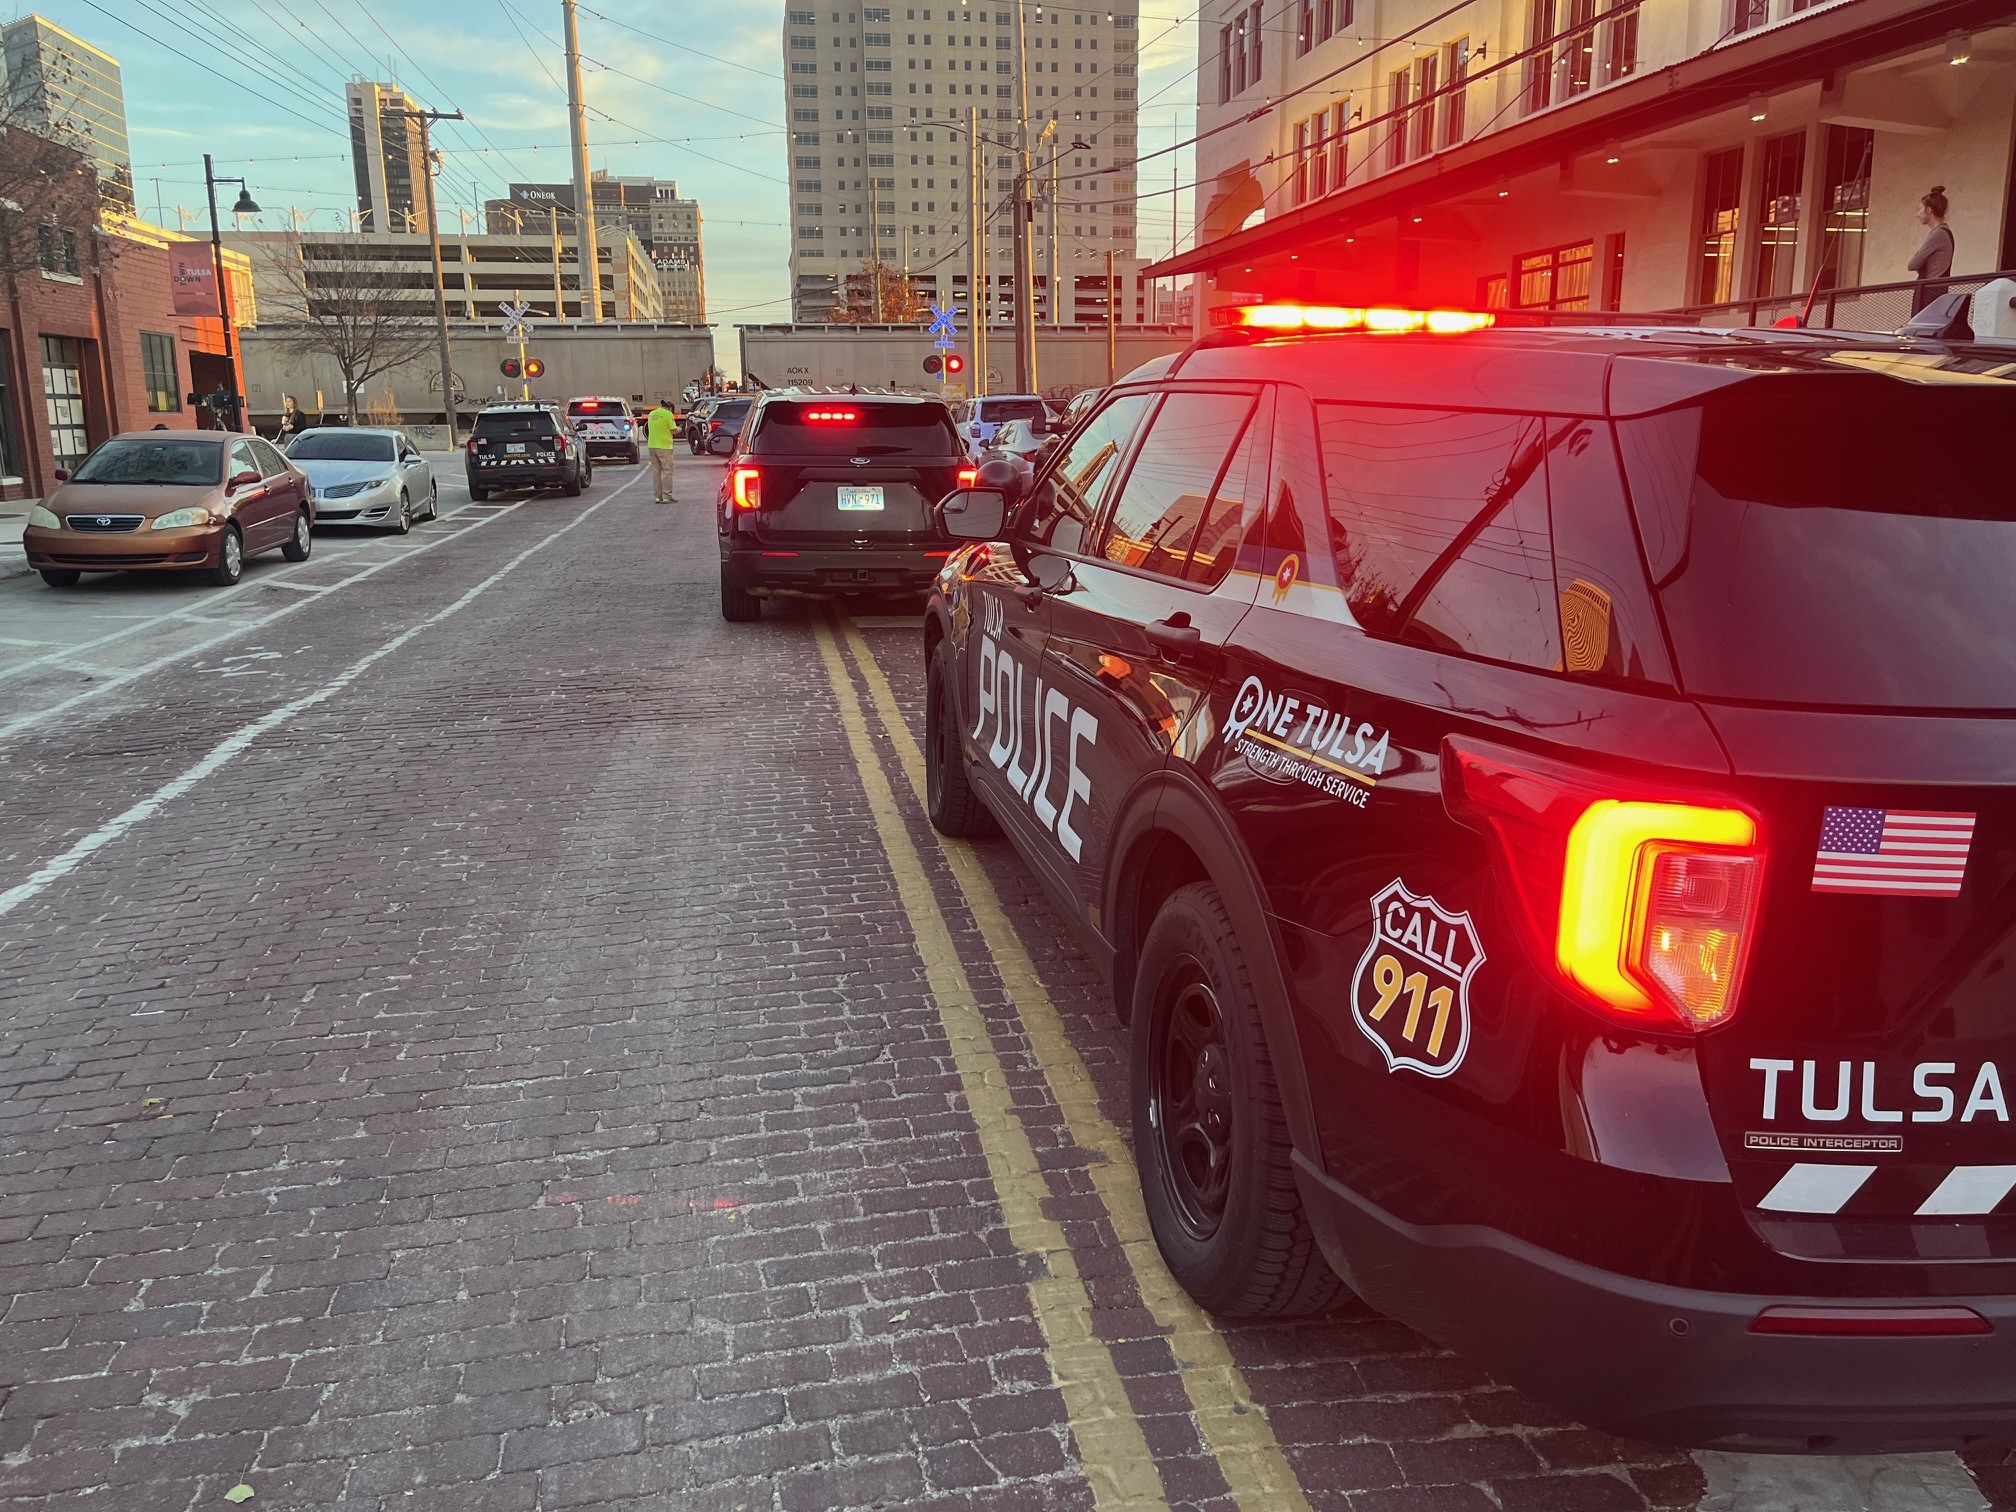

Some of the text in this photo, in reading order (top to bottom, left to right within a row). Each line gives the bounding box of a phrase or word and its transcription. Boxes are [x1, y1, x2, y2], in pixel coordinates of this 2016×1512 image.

[530, 190, 556, 200] ONEOK
[502, 303, 530, 332] CROSSING
[930, 307, 958, 333] CROSSING
[982, 590, 1004, 641] TULSA
[972, 634, 1099, 864] POLICE
[1222, 676, 1389, 775] ONE TULSA
[1234, 738, 1370, 808] STRENGTH THROUGH SERVICE
[1385, 901, 1462, 974] CALL
[1369, 954, 1454, 1058] 911
[1750, 1058, 2010, 1122] TULSA
[1749, 1136, 1898, 1149] POLICE INTERCEPTOR
